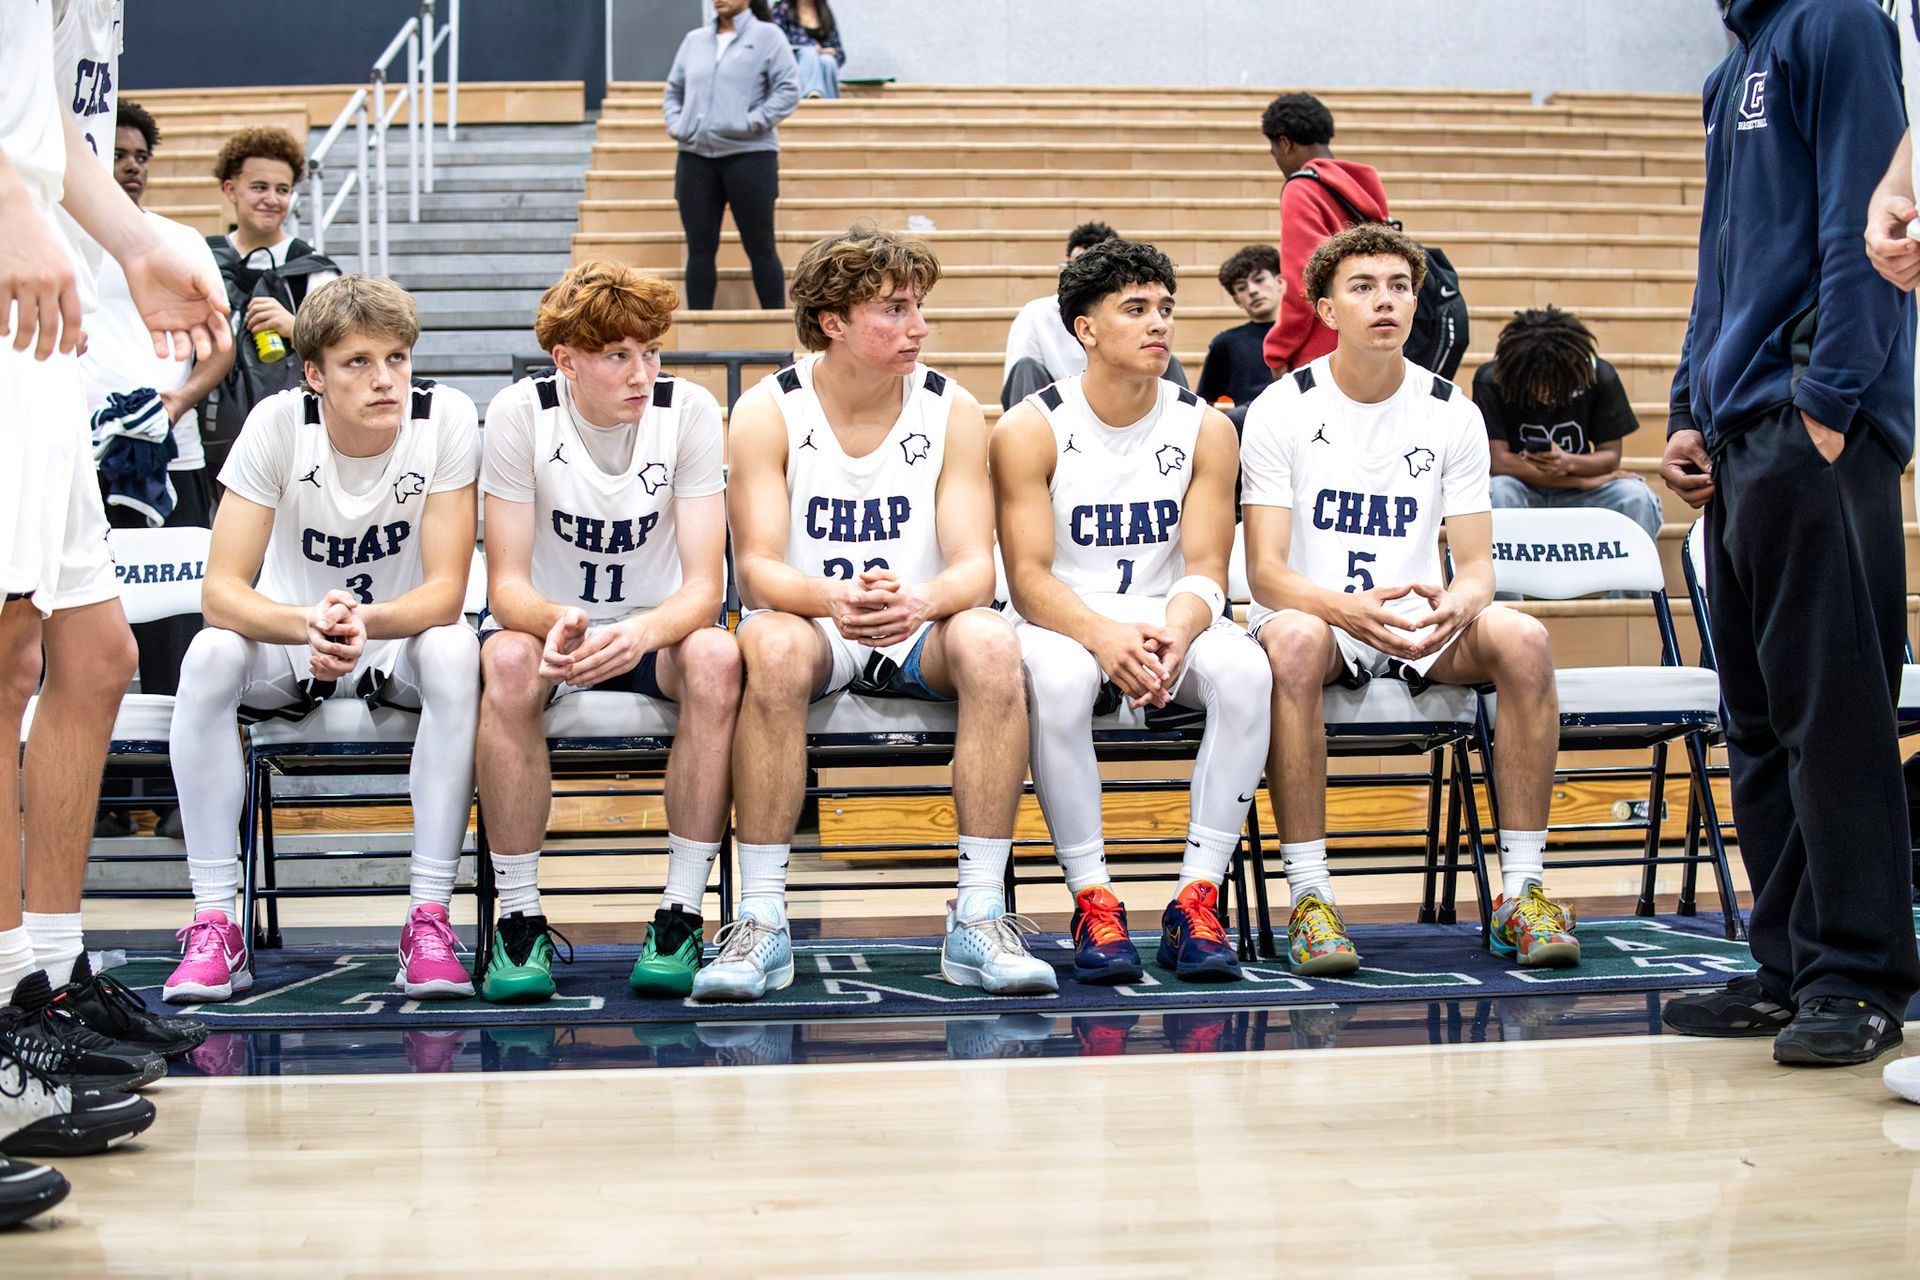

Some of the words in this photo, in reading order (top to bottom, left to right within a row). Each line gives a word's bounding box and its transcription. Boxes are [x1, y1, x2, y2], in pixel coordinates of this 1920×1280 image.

[1740, 71, 1767, 119] C
[551, 509, 659, 554] CHAP
[804, 496, 912, 543] CHAP
[1069, 499, 1180, 547] CHAP
[1312, 488, 1418, 537] CHAP
[301, 520, 411, 568] CHAP
[346, 573, 374, 604] 3
[578, 560, 626, 604] 11
[1343, 550, 1377, 594] 5
